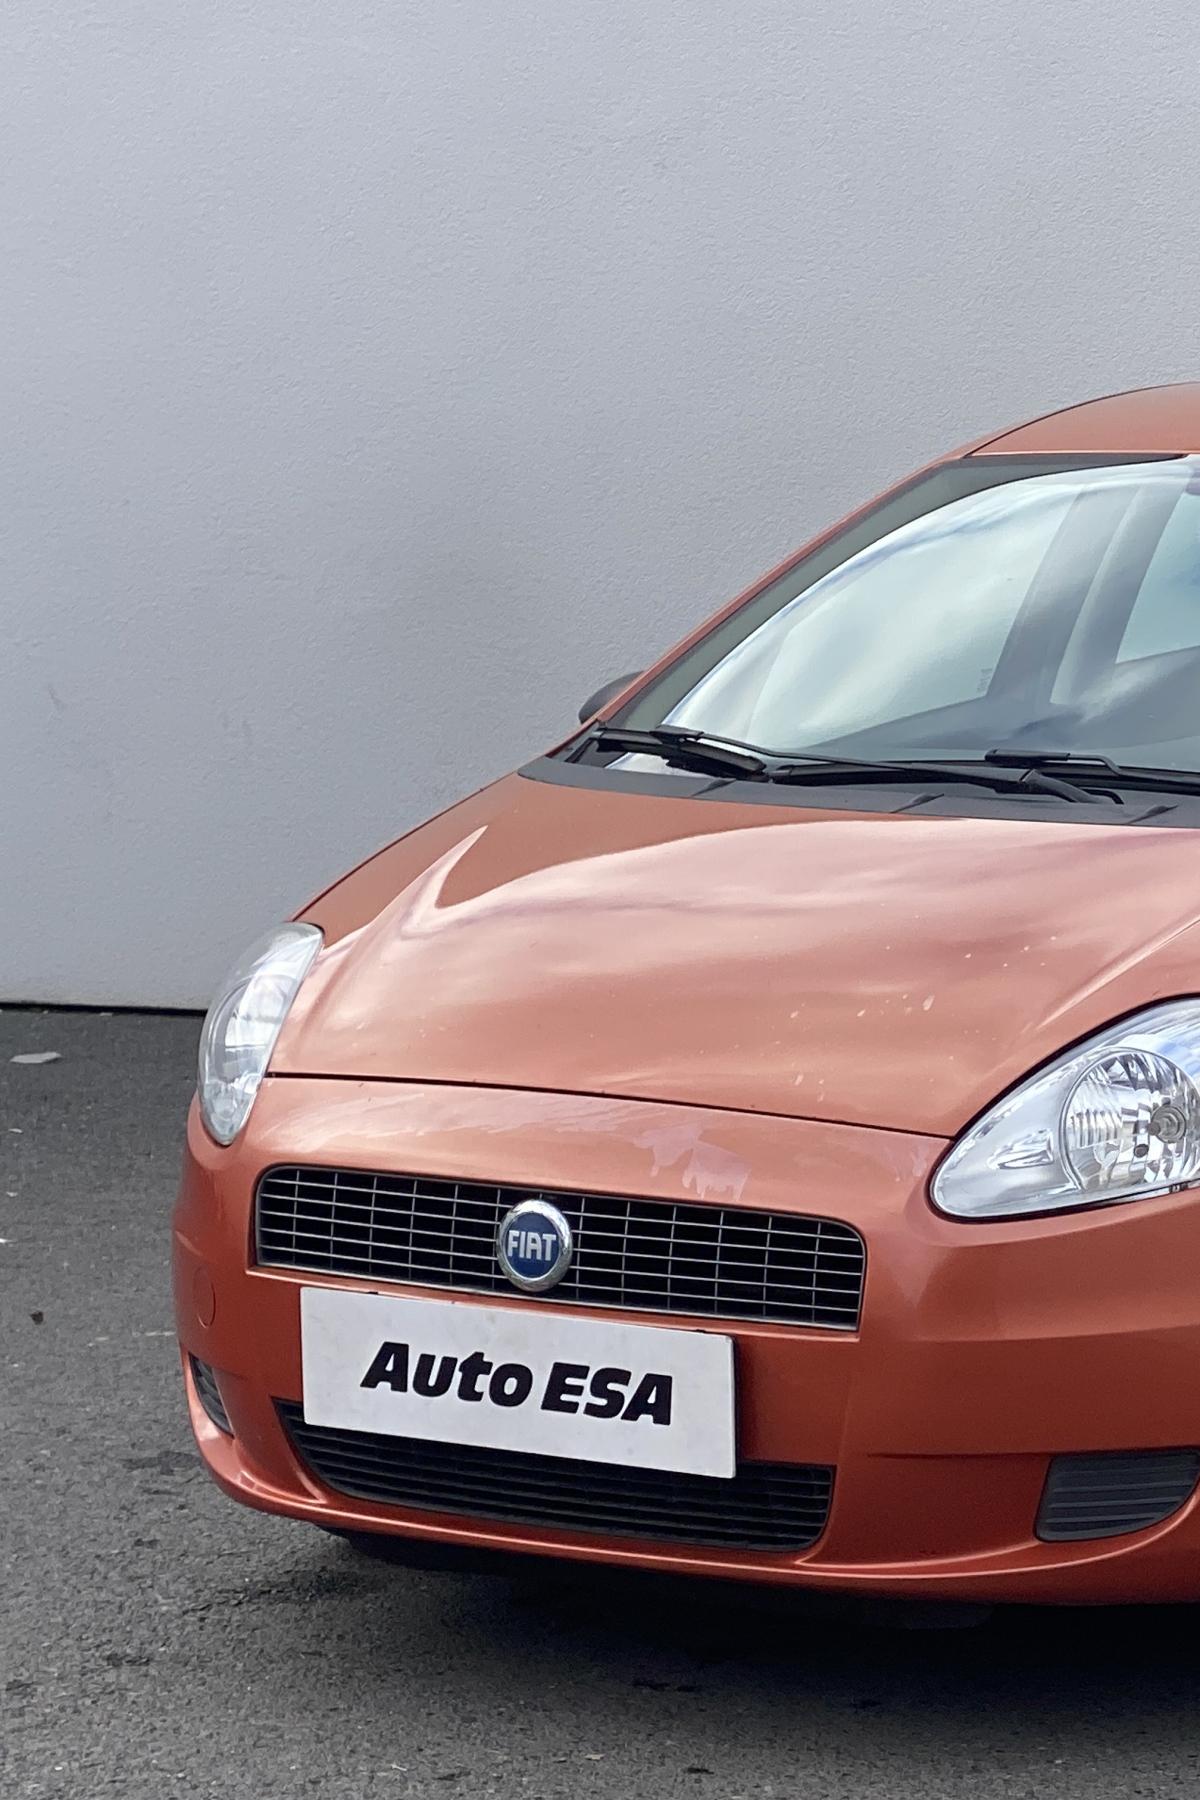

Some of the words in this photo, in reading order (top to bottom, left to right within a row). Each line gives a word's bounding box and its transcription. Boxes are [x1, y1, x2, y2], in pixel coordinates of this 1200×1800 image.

[507, 1230, 557, 1261] FIAT
[360, 1341, 533, 1407] Auto
[541, 1362, 673, 1425] ESA
